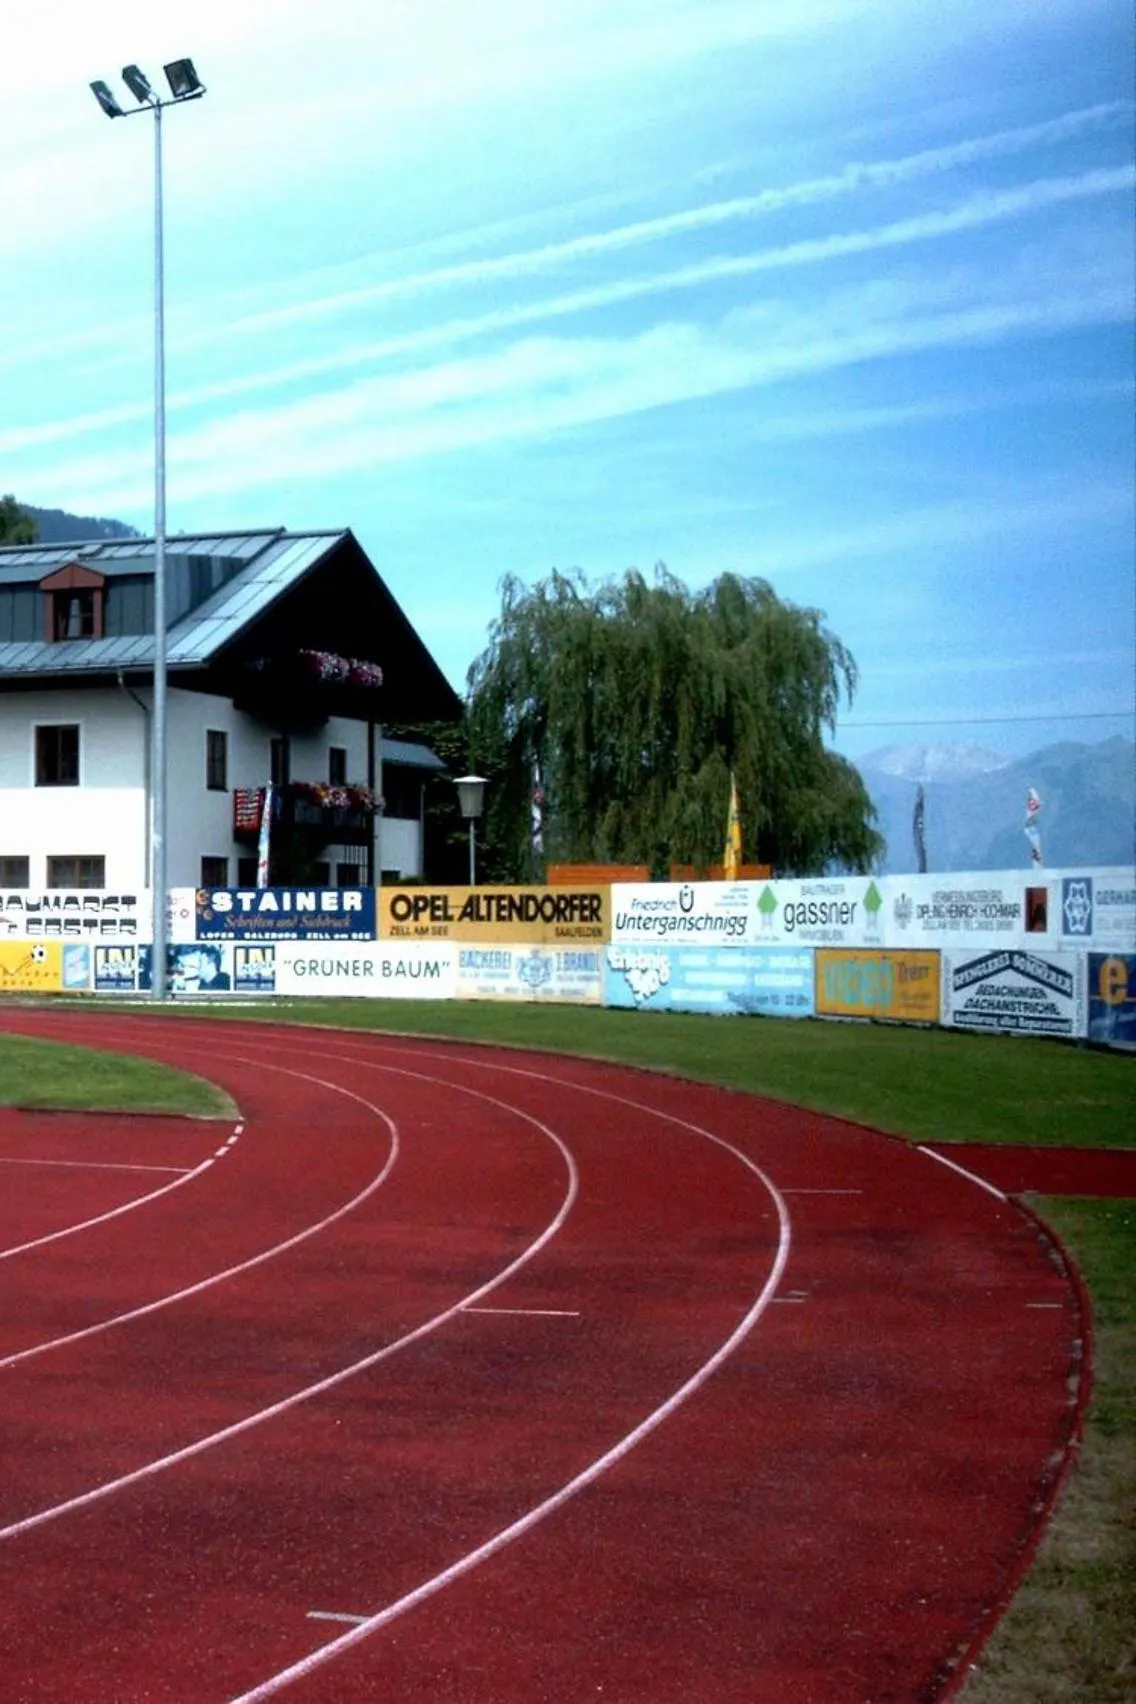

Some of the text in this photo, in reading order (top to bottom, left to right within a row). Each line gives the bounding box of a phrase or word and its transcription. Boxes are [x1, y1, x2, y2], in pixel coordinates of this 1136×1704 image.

[211, 891, 363, 912] STAINER
[390, 894, 603, 923] OPEL ALTENDORFER
[25, 917, 137, 935] EBSTER
[615, 910, 749, 936] Unterganschnigg
[783, 901, 857, 932] gassner
